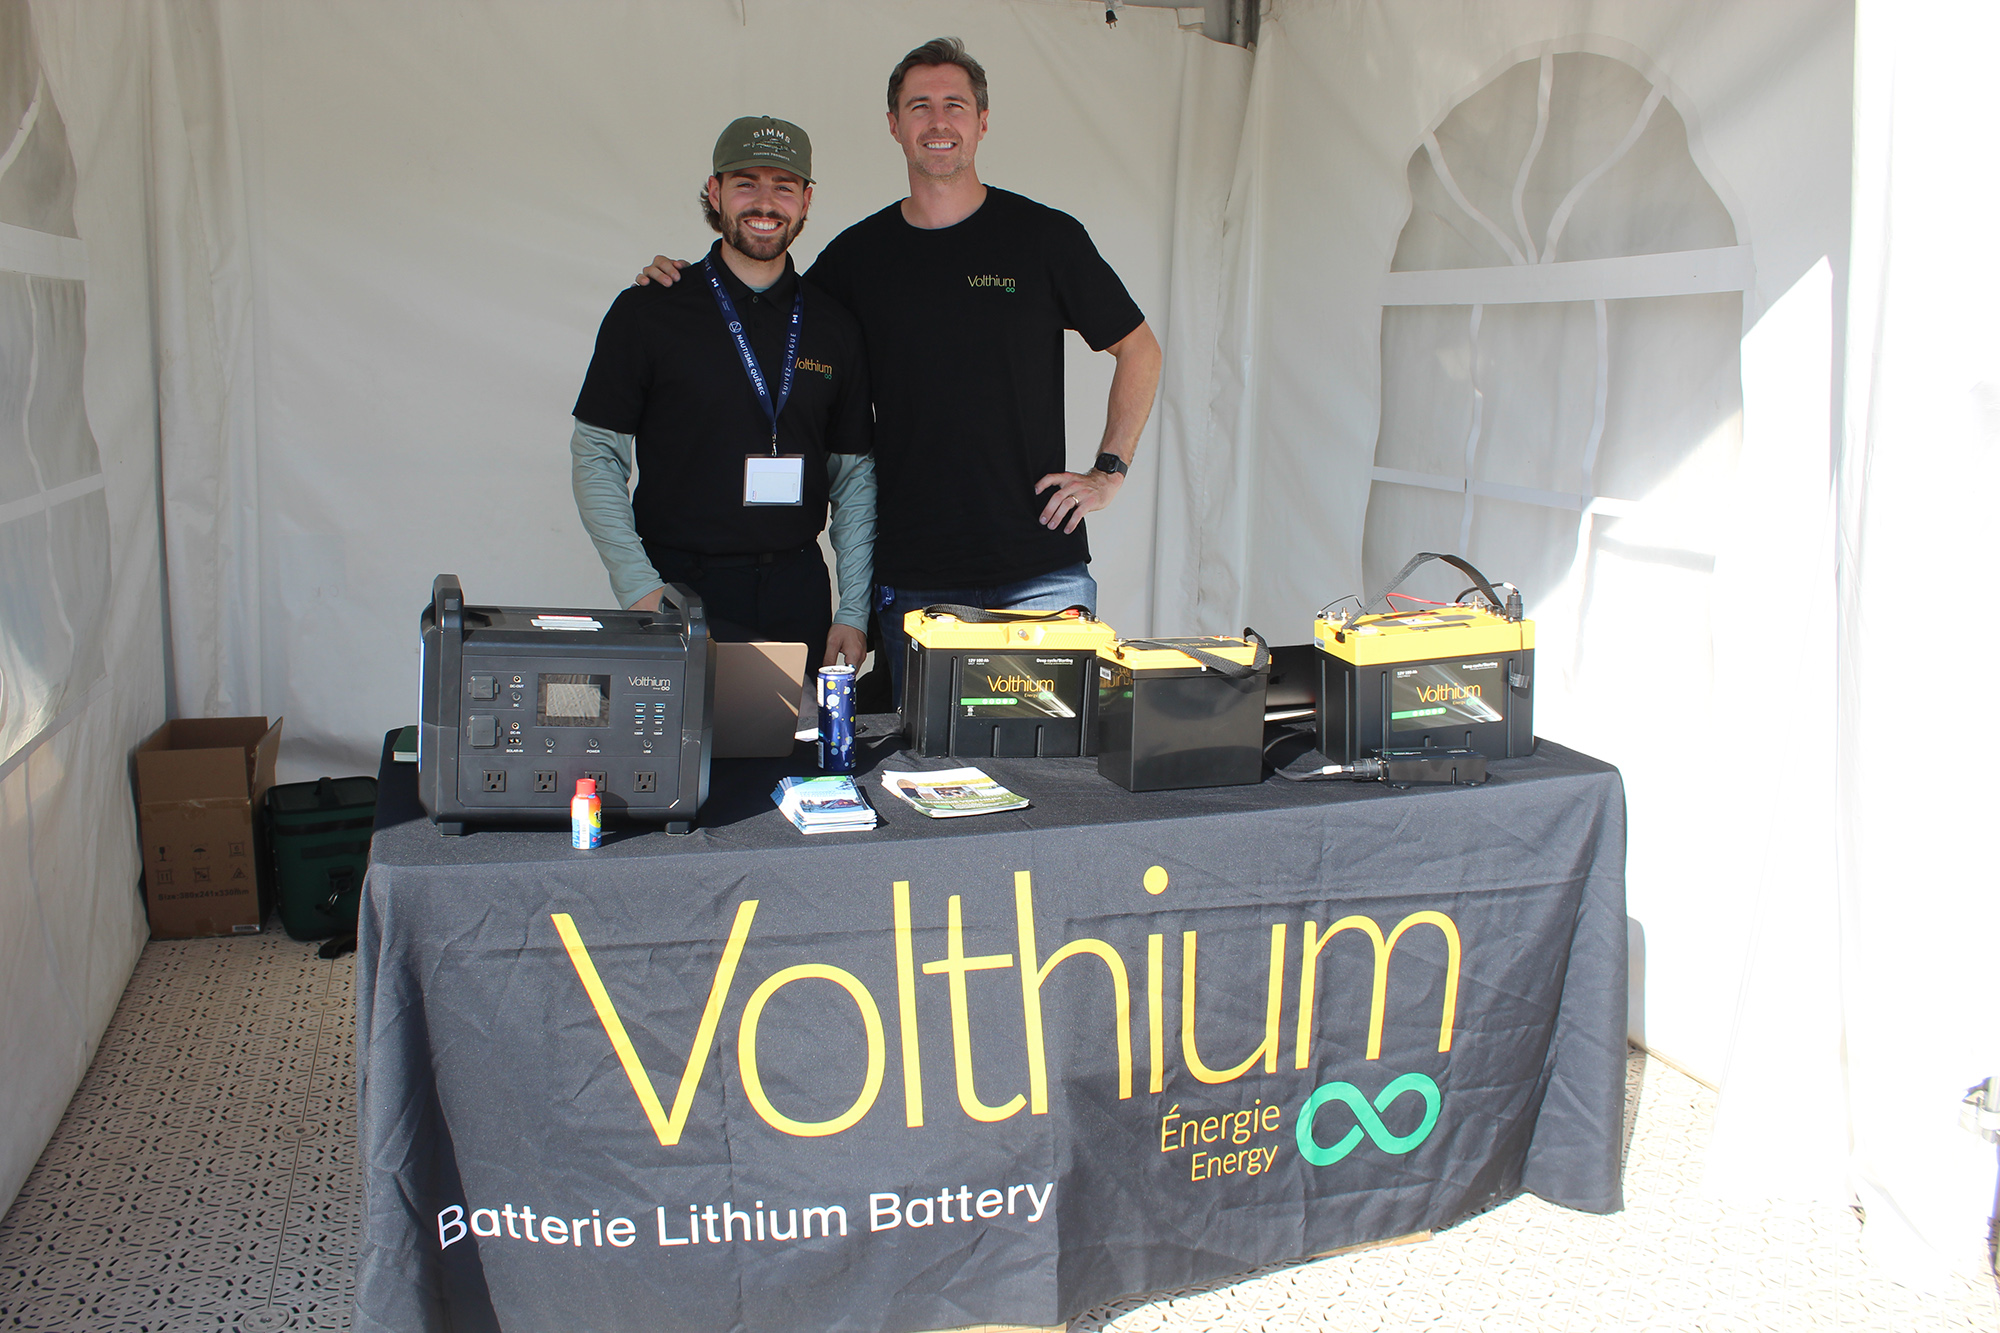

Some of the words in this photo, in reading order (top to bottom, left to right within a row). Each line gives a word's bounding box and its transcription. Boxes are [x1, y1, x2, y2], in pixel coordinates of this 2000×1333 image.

[753, 128, 791, 144] SIMMS
[967, 274, 1016, 287] Volthium
[736, 334, 755, 368] NAUTISME
[750, 368, 766, 396] QUÉBEC
[628, 676, 670, 688] Volthium
[986, 675, 1055, 692] Volthium
[1416, 682, 1482, 703] Volthium
[551, 866, 1462, 1147] Volthium
[1161, 1098, 1281, 1152] Énergie
[1191, 1145, 1279, 1182] Energy
[437, 1203, 637, 1250] Batterie
[657, 1201, 849, 1246] Lithium
[869, 1183, 1055, 1232] Battery
